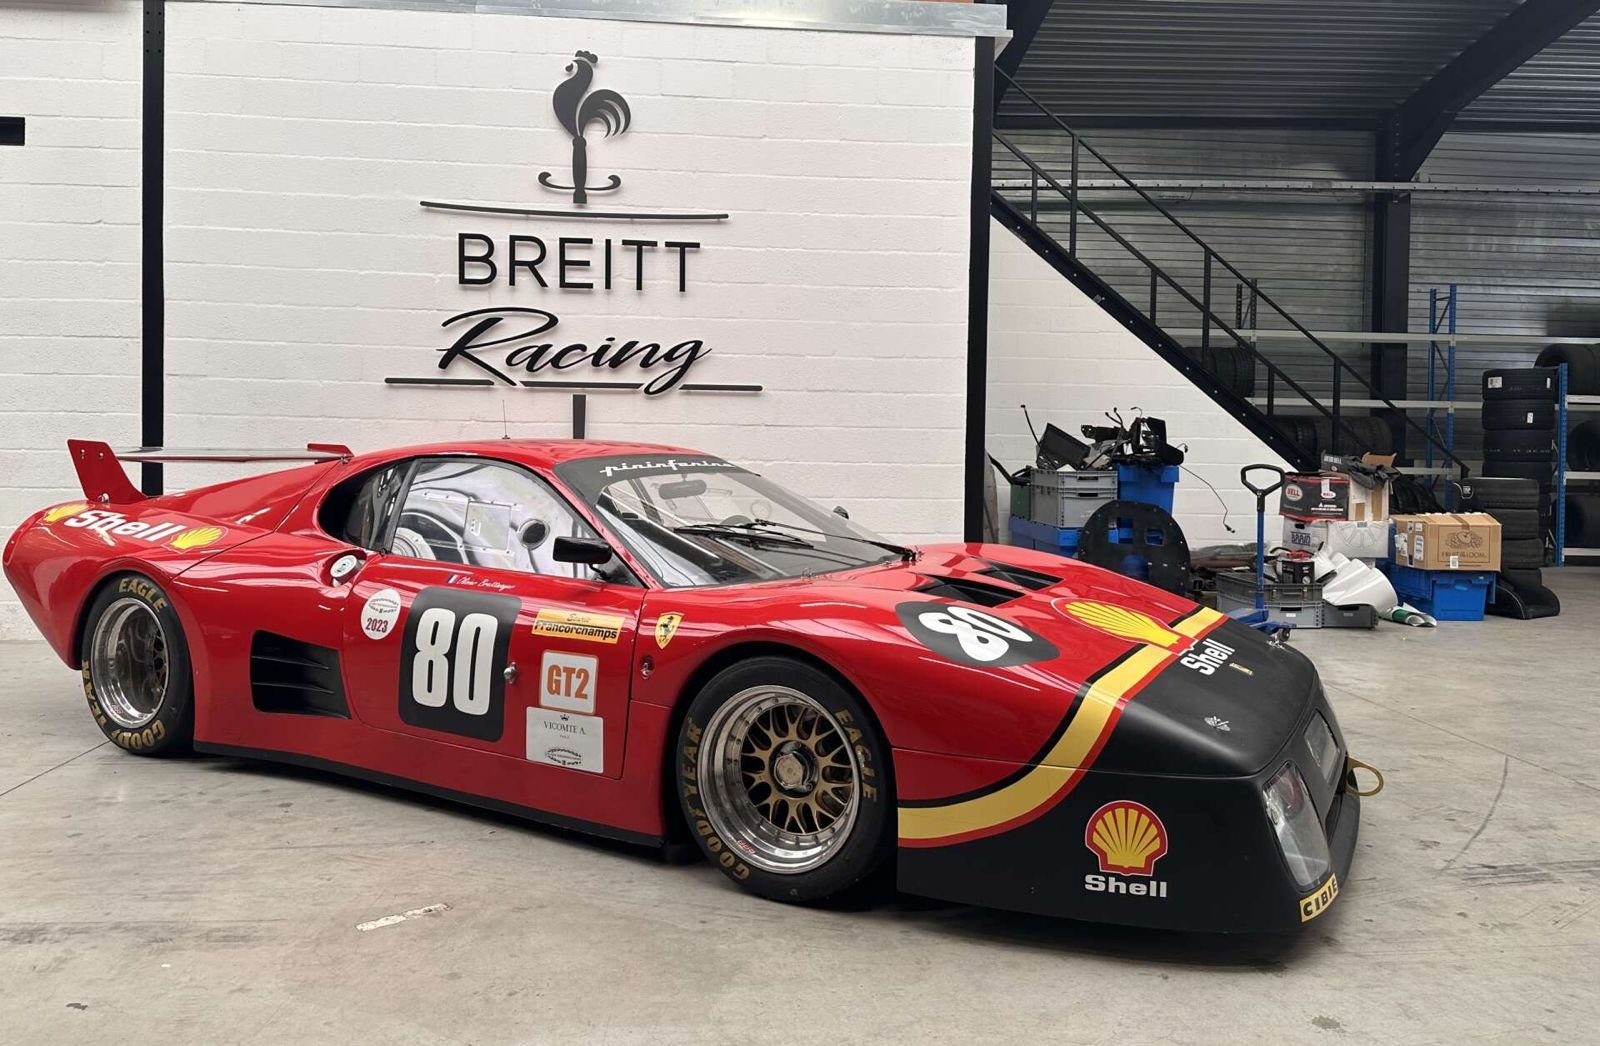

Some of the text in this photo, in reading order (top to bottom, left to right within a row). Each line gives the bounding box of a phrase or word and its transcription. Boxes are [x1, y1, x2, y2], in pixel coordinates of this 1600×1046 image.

[458, 233, 701, 292] BREITT
[436, 307, 712, 395] Racing
[1287, 487, 1300, 497] BELL
[63, 510, 188, 542] Shell
[118, 578, 167, 614] EAGLE
[365, 617, 388, 633] 2023
[534, 620, 618, 640] Francorchamps
[918, 606, 1033, 662] 80
[412, 607, 499, 716] 80
[1180, 638, 1235, 675] Shell
[546, 664, 590, 700] GT2
[543, 720, 578, 734] VICOMTE
[835, 709, 878, 803] EAGLE
[1085, 874, 1168, 898] Shell
[1303, 877, 1338, 917] CIBIE
